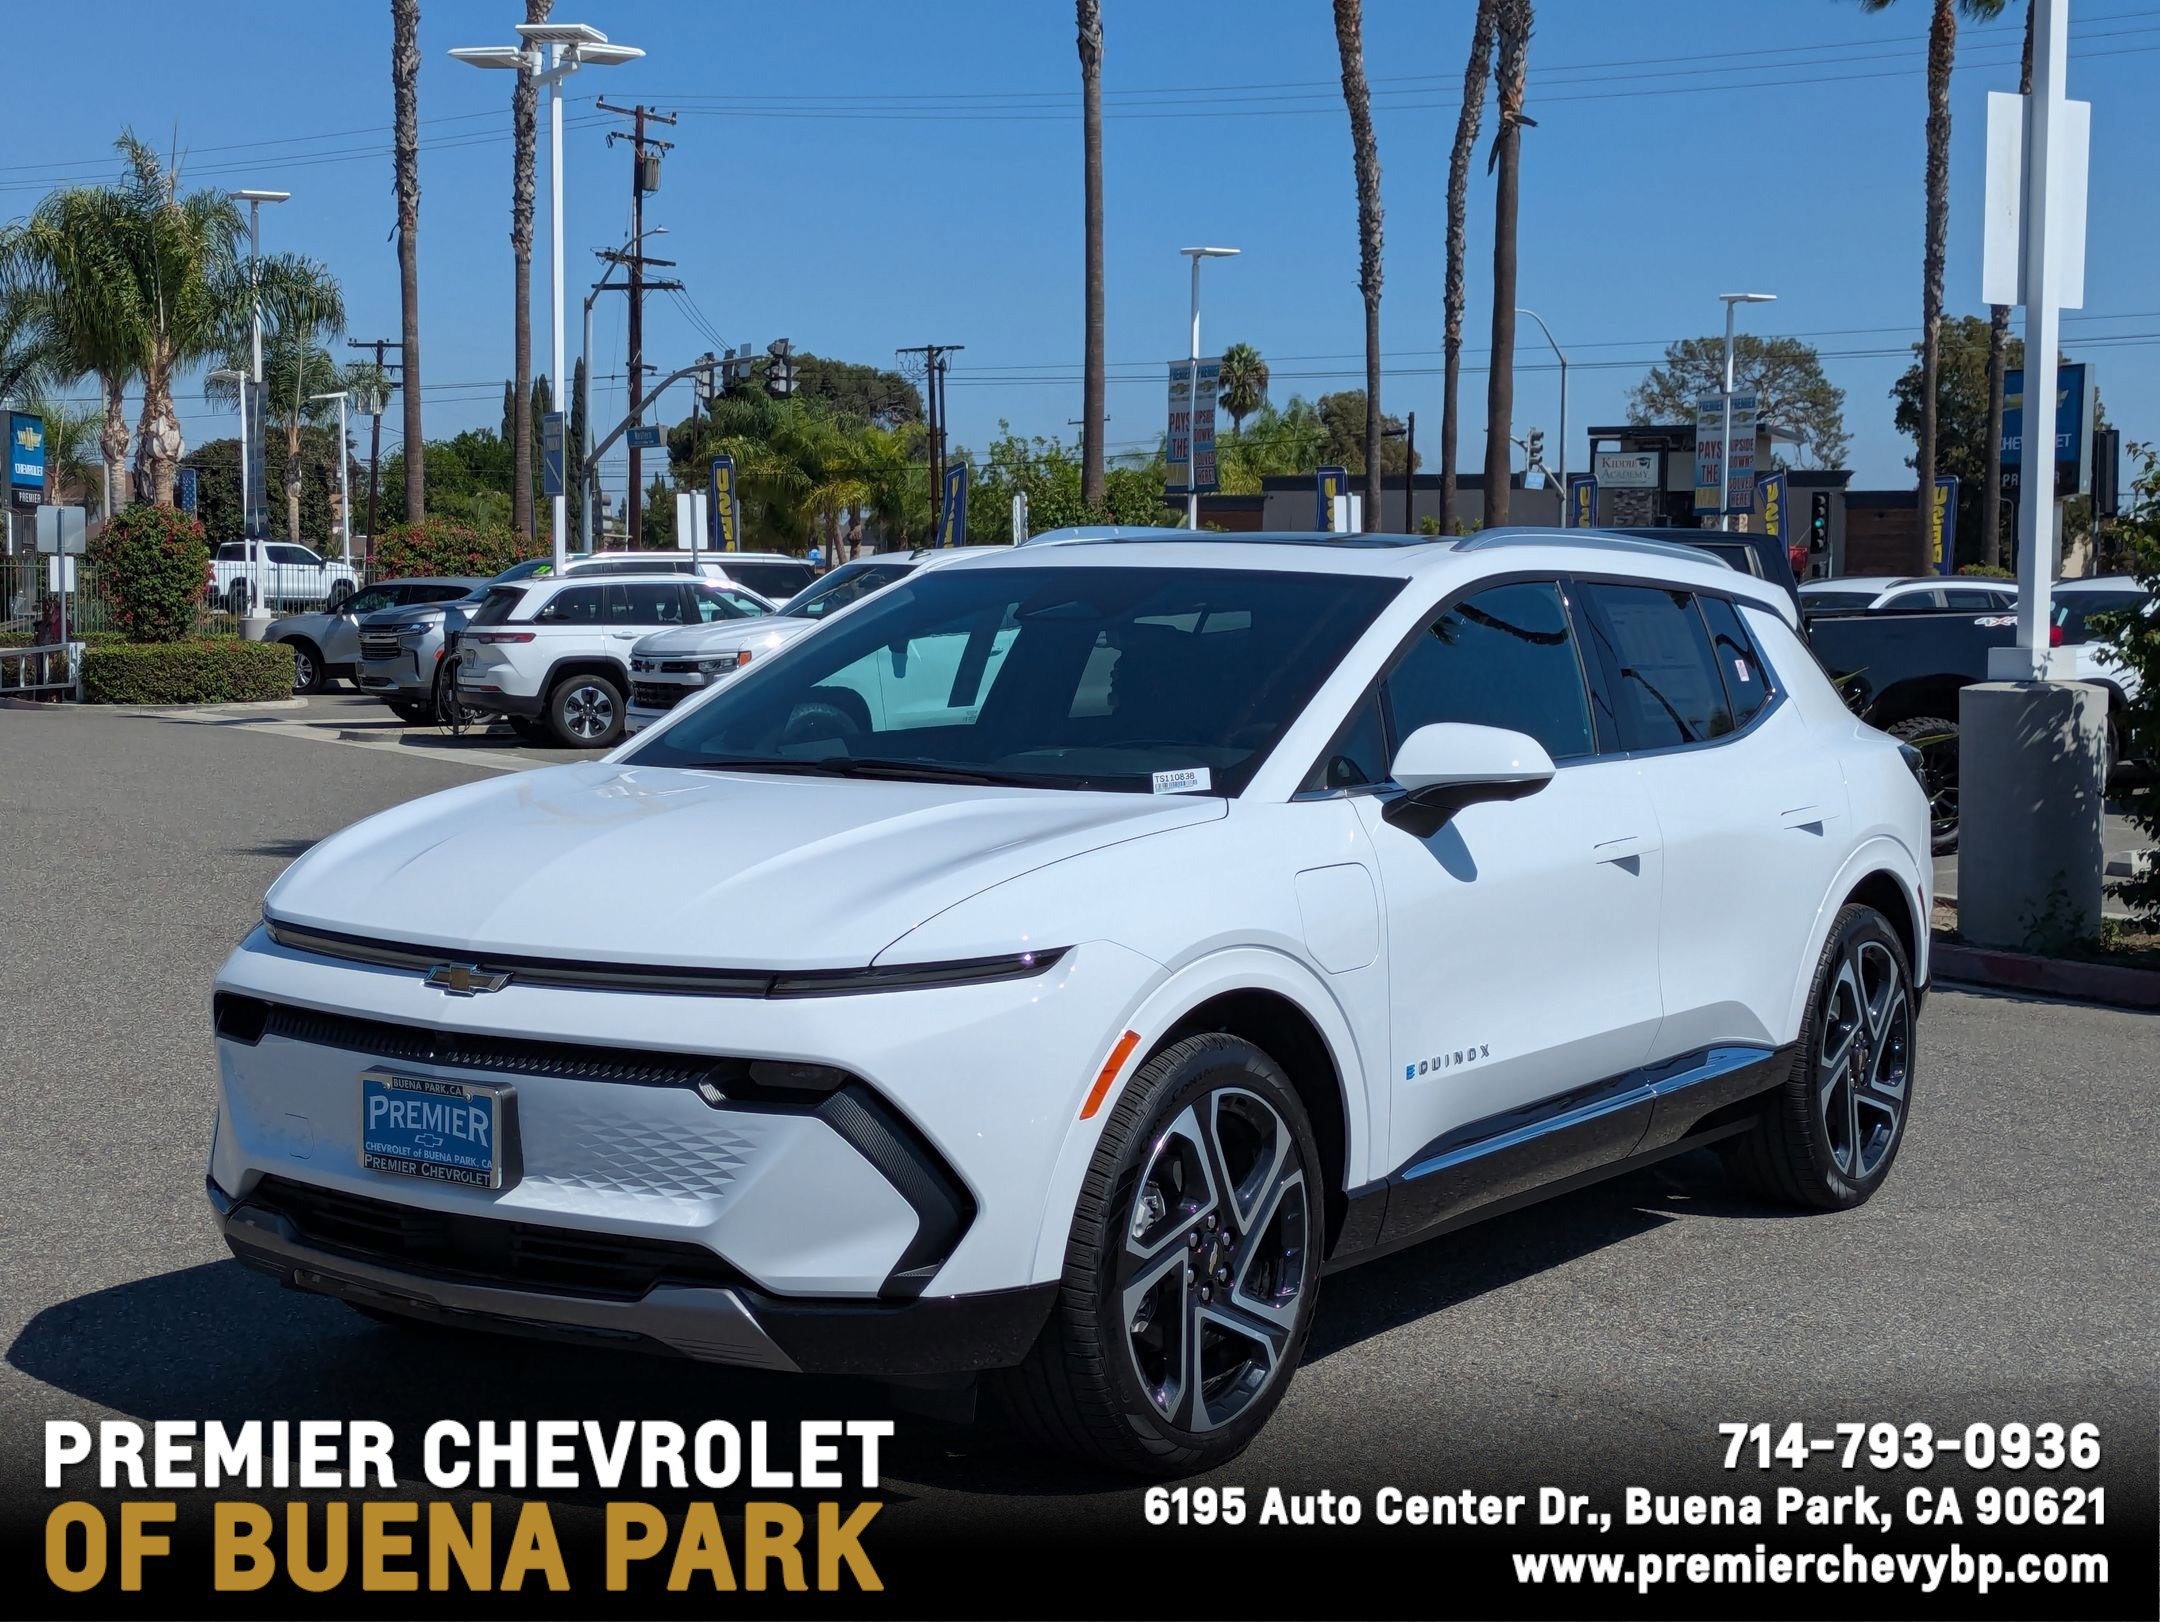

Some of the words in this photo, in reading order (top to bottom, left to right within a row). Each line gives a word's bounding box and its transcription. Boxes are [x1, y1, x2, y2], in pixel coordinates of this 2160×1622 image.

[1169, 411, 1190, 433] PAYS
[1172, 437, 1188, 459] THE
[1698, 440, 1722, 460] PAYS
[1602, 457, 1637, 468] KIDDIE
[1701, 464, 1719, 483] THE
[19, 491, 41, 503] PREMIER
[1765, 481, 1779, 537] USE
[1154, 771, 1195, 783] TS110838
[1406, 1043, 1490, 1081] EQUINOX
[393, 1078, 422, 1090] BUENA
[368, 1094, 489, 1148] PREMIER
[365, 1141, 411, 1156] CHEVROLET
[413, 1149, 422, 1158] of
[423, 1150, 452, 1162] BUENA
[481, 1159, 492, 1169] CA
[364, 1153, 417, 1175] PREMIER
[421, 1162, 490, 1186] CHEVROLET
